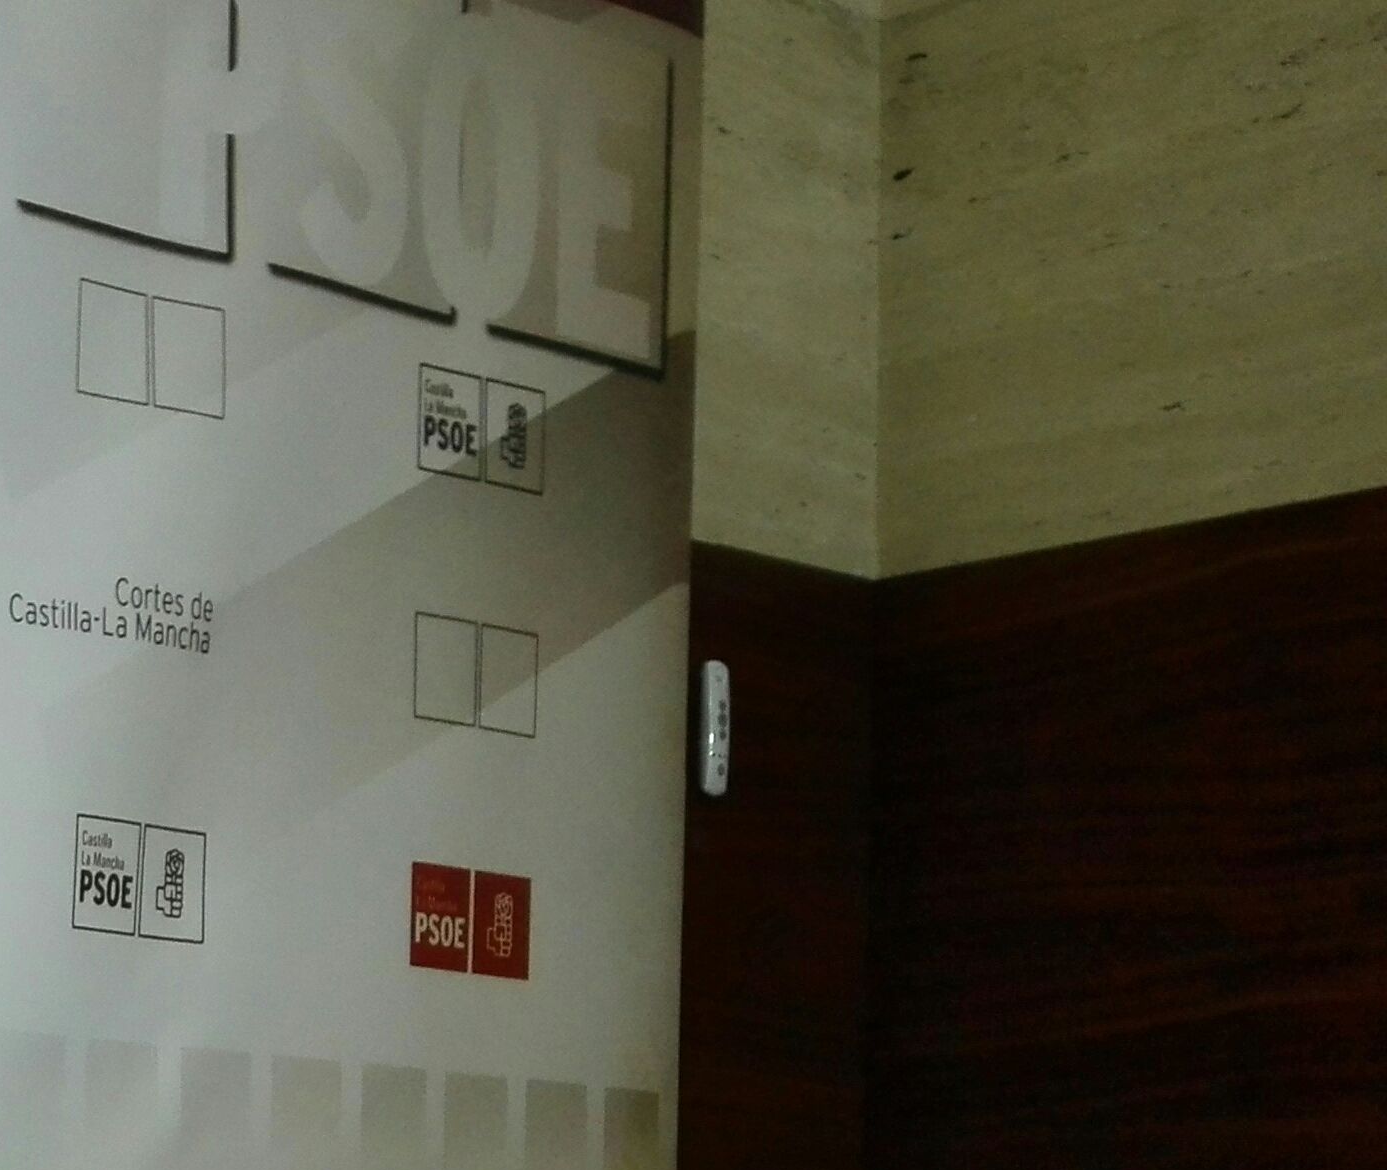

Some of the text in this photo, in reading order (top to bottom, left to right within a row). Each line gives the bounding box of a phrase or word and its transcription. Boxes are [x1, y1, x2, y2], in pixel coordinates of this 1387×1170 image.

[423, 414, 478, 457] PSOE
[114, 577, 214, 622] Cortes de
[134, 612, 212, 654] Mancha
[79, 869, 134, 909] PSOE
[414, 911, 466, 949] PSOE
